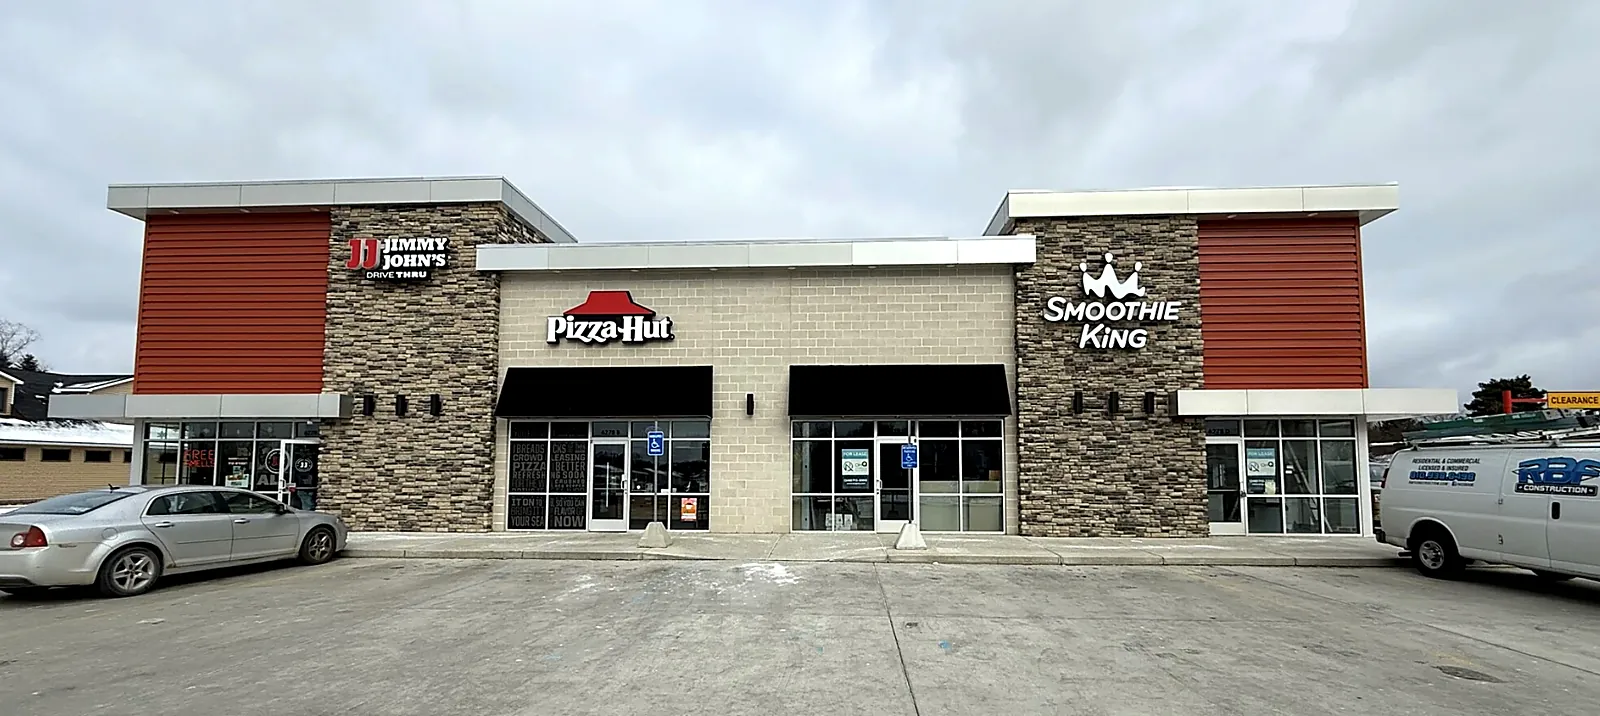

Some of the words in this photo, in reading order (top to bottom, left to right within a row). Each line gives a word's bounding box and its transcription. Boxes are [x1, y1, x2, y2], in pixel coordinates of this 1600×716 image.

[383, 238, 448, 254] JIMMY
[346, 238, 381, 270] JJ
[382, 254, 446, 270] JOHN'S
[395, 271, 427, 279] THRU
[1043, 296, 1182, 322] SMOOTHIE
[547, 315, 618, 343] Pizza
[618, 315, 671, 342] Hut
[1551, 396, 1599, 405] CLEARANCE
[512, 453, 543, 462] CROWD
[512, 461, 546, 472] PIZZA
[555, 461, 586, 472] BETTER
[562, 471, 585, 479] SODA
[1523, 484, 1588, 494] CONSTRUCTION
[522, 498, 535, 506] ON
[510, 515, 530, 527] YOUR
[554, 515, 585, 528] NOW
